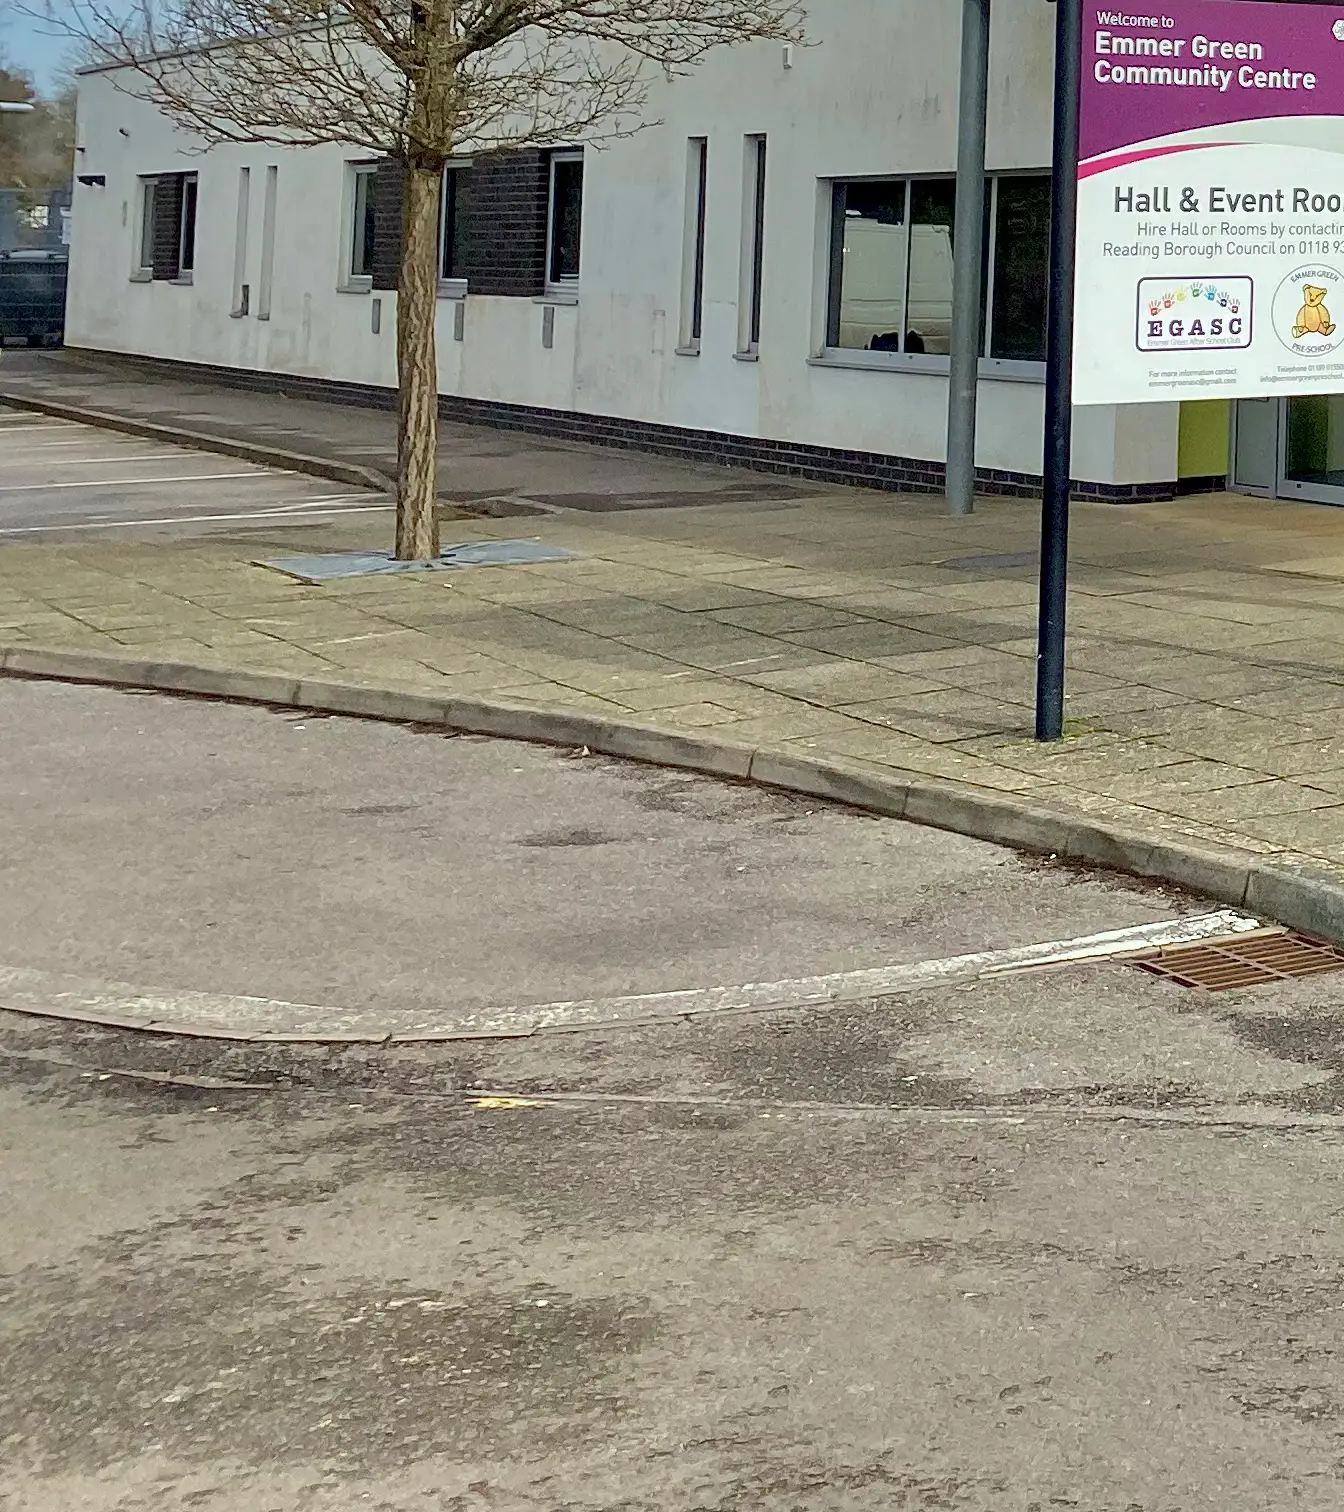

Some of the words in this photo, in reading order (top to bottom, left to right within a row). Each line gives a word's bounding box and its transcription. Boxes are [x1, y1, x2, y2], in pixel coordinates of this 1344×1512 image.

[1096, 10, 1159, 28] Welcome
[1161, 15, 1175, 29] to
[1095, 30, 1186, 57] Emmer
[1191, 35, 1263, 60] Green
[1094, 60, 1233, 93] Community
[1238, 65, 1316, 90] Centre
[1114, 186, 1171, 213] Hall
[1179, 186, 1200, 213] &
[1208, 187, 1284, 213] Event
[1137, 221, 1167, 236] Hire
[1171, 221, 1199, 236] Hall
[1202, 225, 1217, 236] or
[1220, 221, 1267, 236] Rooms
[1270, 221, 1286, 238] by
[1103, 242, 1160, 259] Reading
[1164, 241, 1223, 259] Borough
[1226, 241, 1276, 255] Council
[1279, 244, 1295, 255] on
[1298, 240, 1330, 255] 0118
[1290, 270, 1316, 283] EMMER
[1317, 270, 1340, 282] GREEN
[1291, 342, 1336, 353] PRE-SCHOOL
